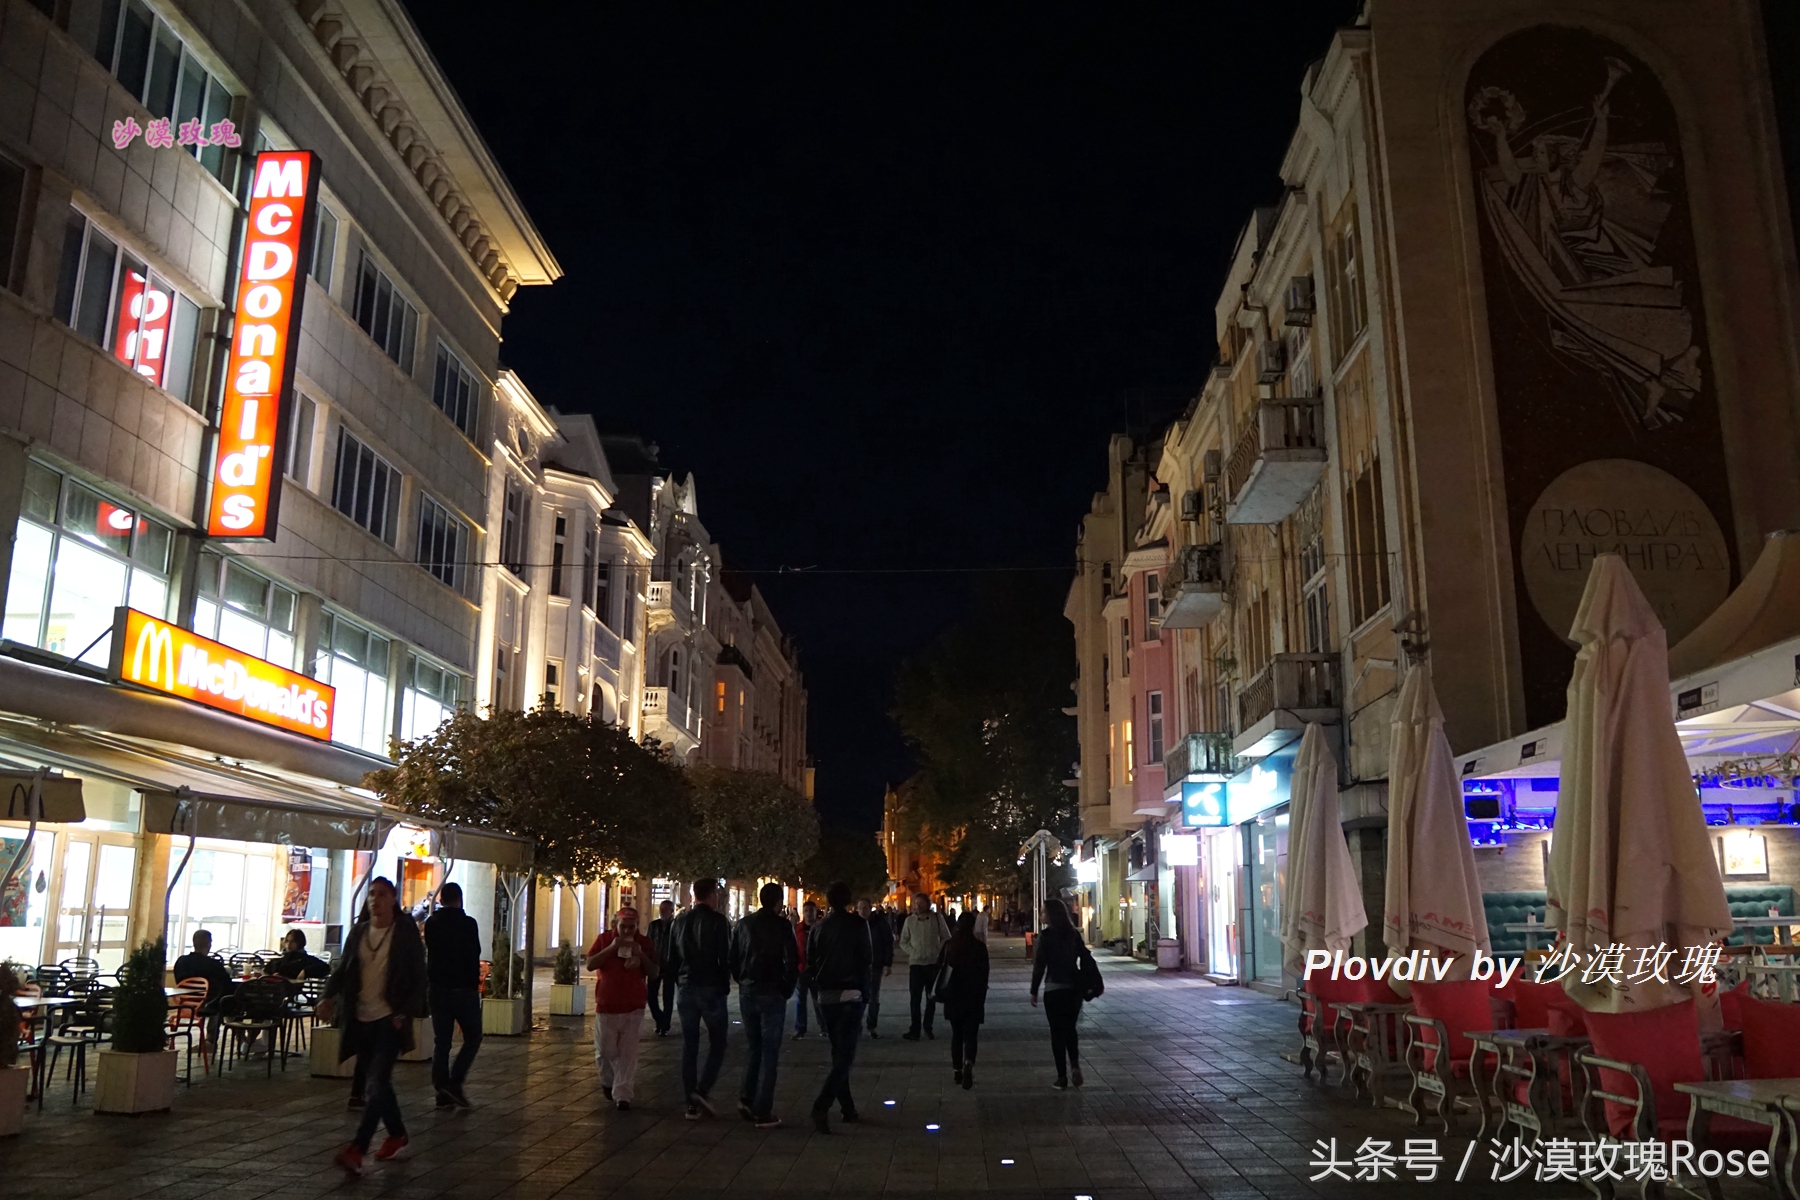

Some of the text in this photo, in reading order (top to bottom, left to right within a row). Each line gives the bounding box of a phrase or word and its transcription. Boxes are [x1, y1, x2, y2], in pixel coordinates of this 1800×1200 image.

[220, 159, 304, 530] McDonald's
[1542, 507, 1702, 537] ПЛОВДИВ
[177, 643, 329, 729] McDonald's
